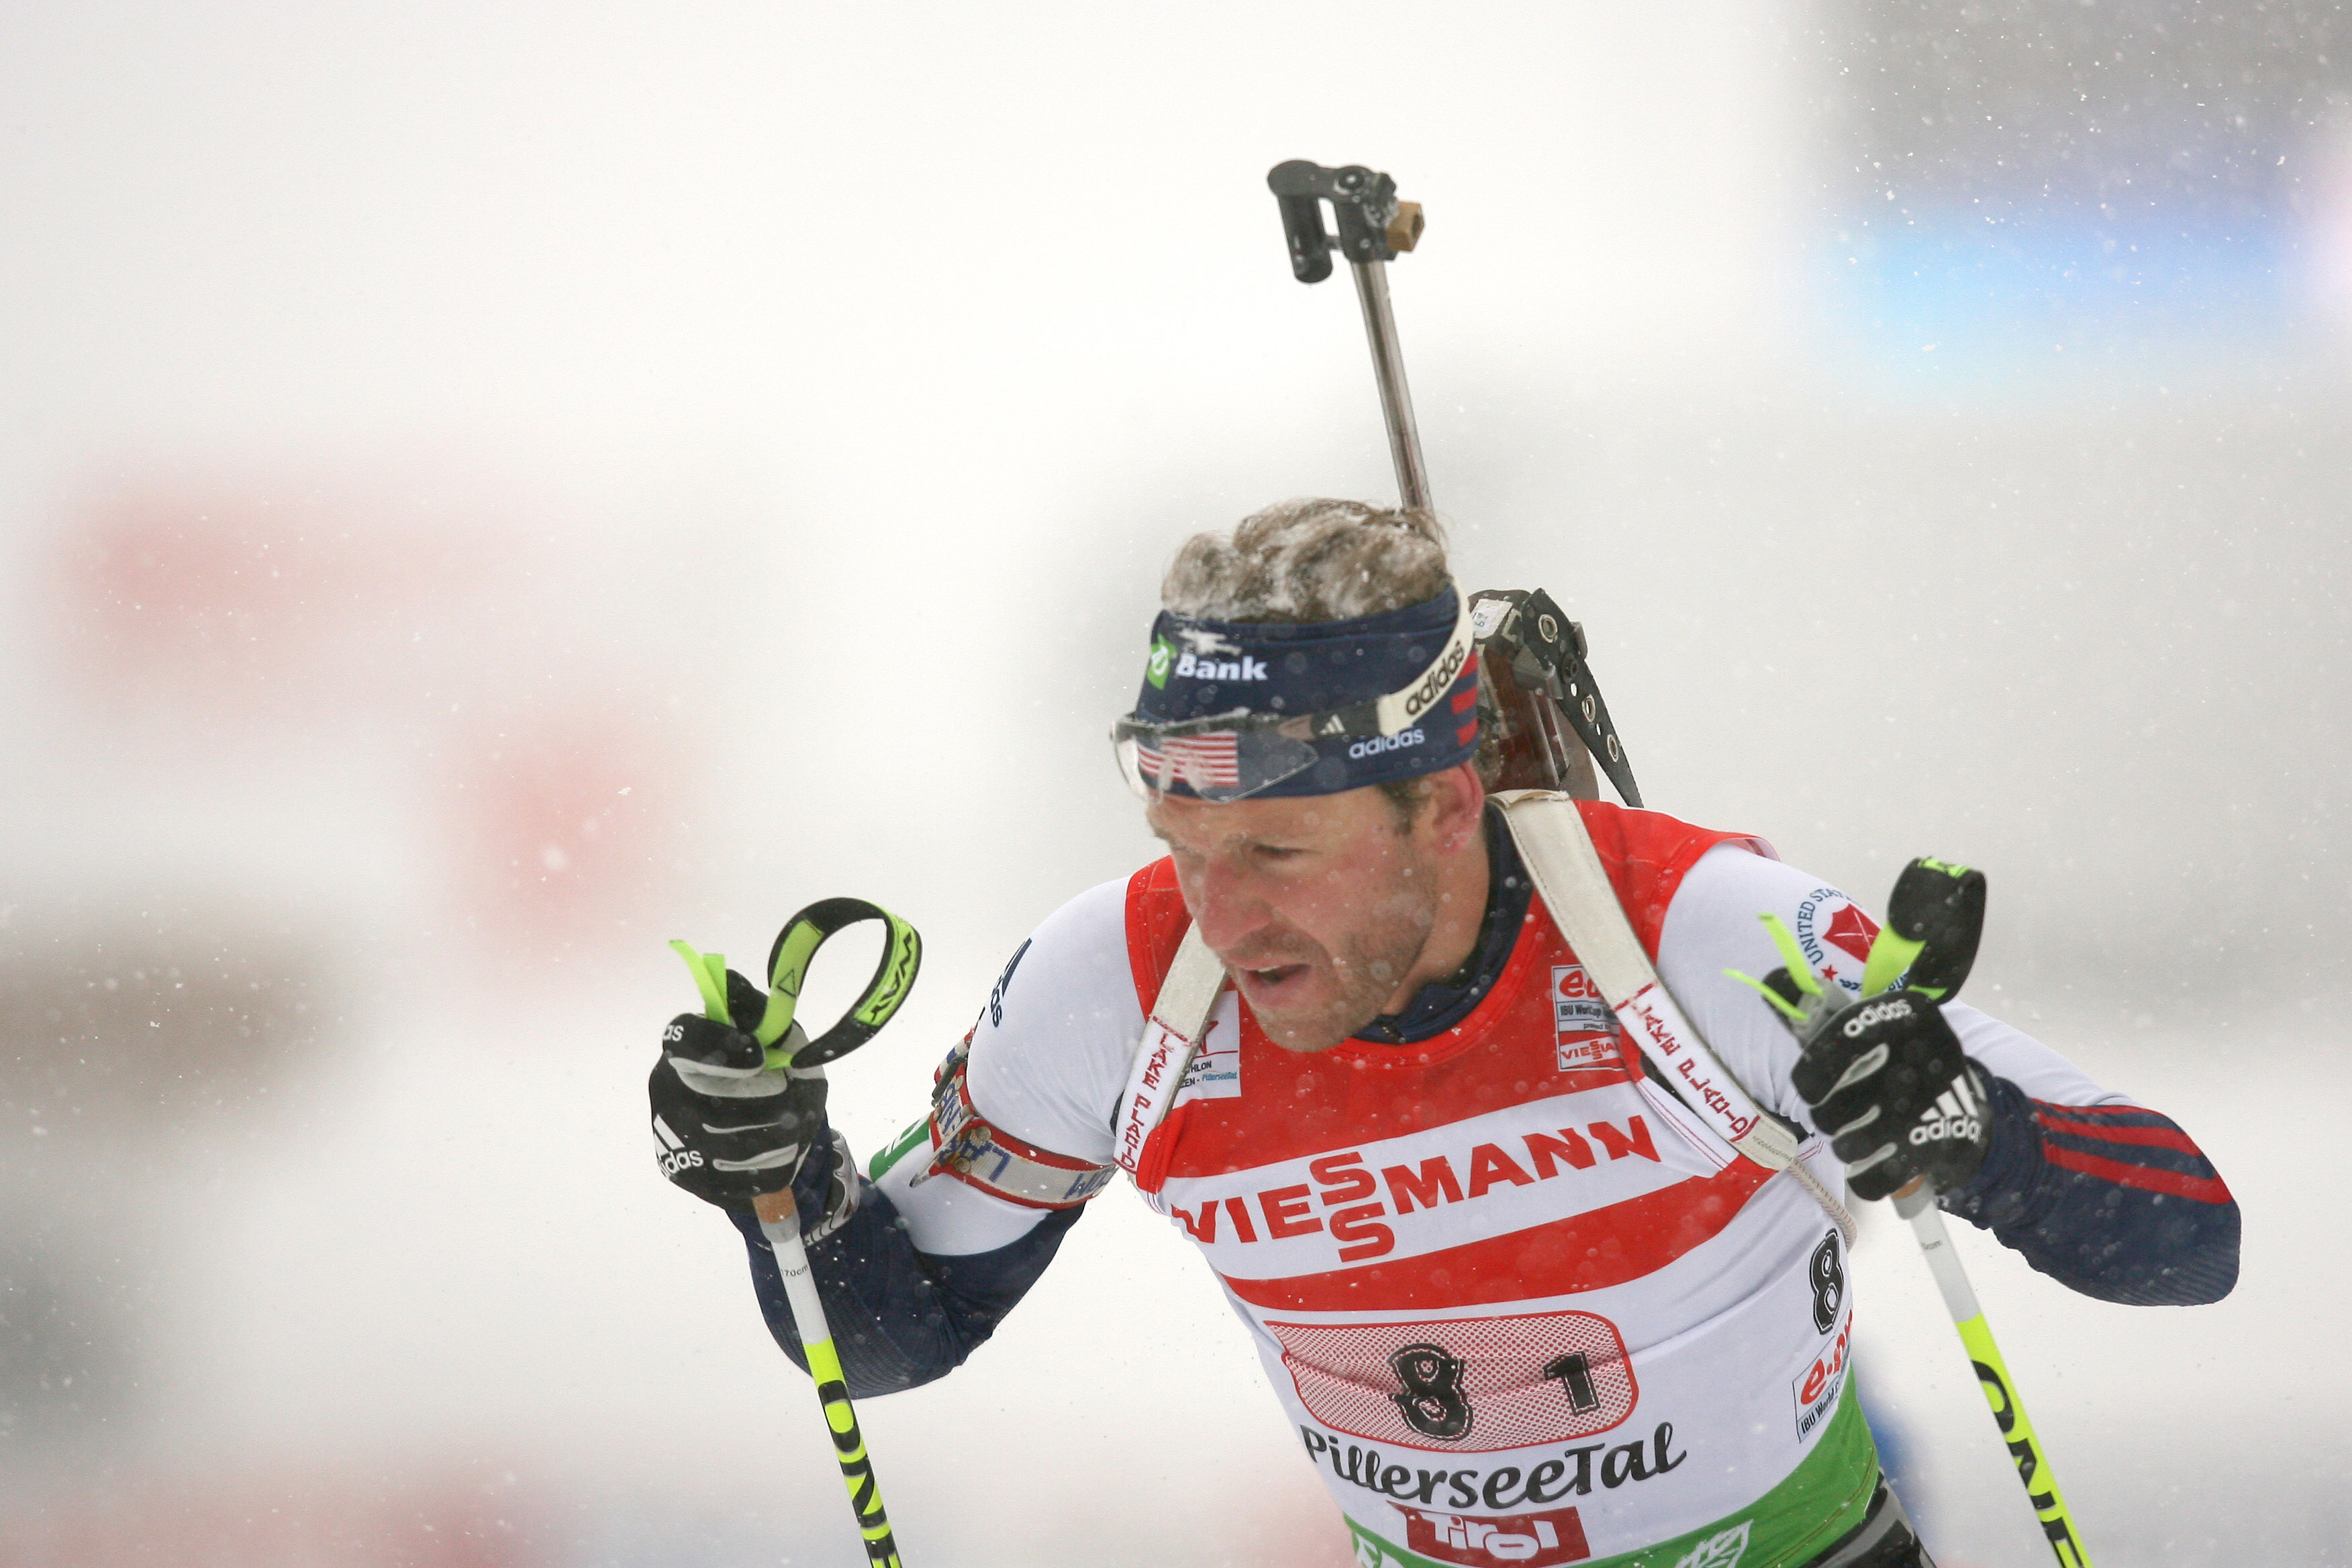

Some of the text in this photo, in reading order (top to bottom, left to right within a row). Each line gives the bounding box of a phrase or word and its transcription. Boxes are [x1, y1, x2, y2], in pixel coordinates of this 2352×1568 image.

[1175, 652, 1268, 681] Bank
[1406, 640, 1465, 715] adidas
[1349, 728, 1426, 759] adidas
[1798, 901, 1824, 965] UNITED
[1843, 999, 1912, 1037] adidas
[1121, 1032, 1174, 1169] LAKE PLACID
[1632, 1001, 1749, 1134] LAKE PLACID
[1909, 1116, 1982, 1145] adida
[1171, 1115, 1662, 1263] VIESSMANN
[1809, 1228, 1845, 1334] 8
[1389, 1343, 1600, 1440] 8 1
[1801, 1412, 1816, 1434] IBU
